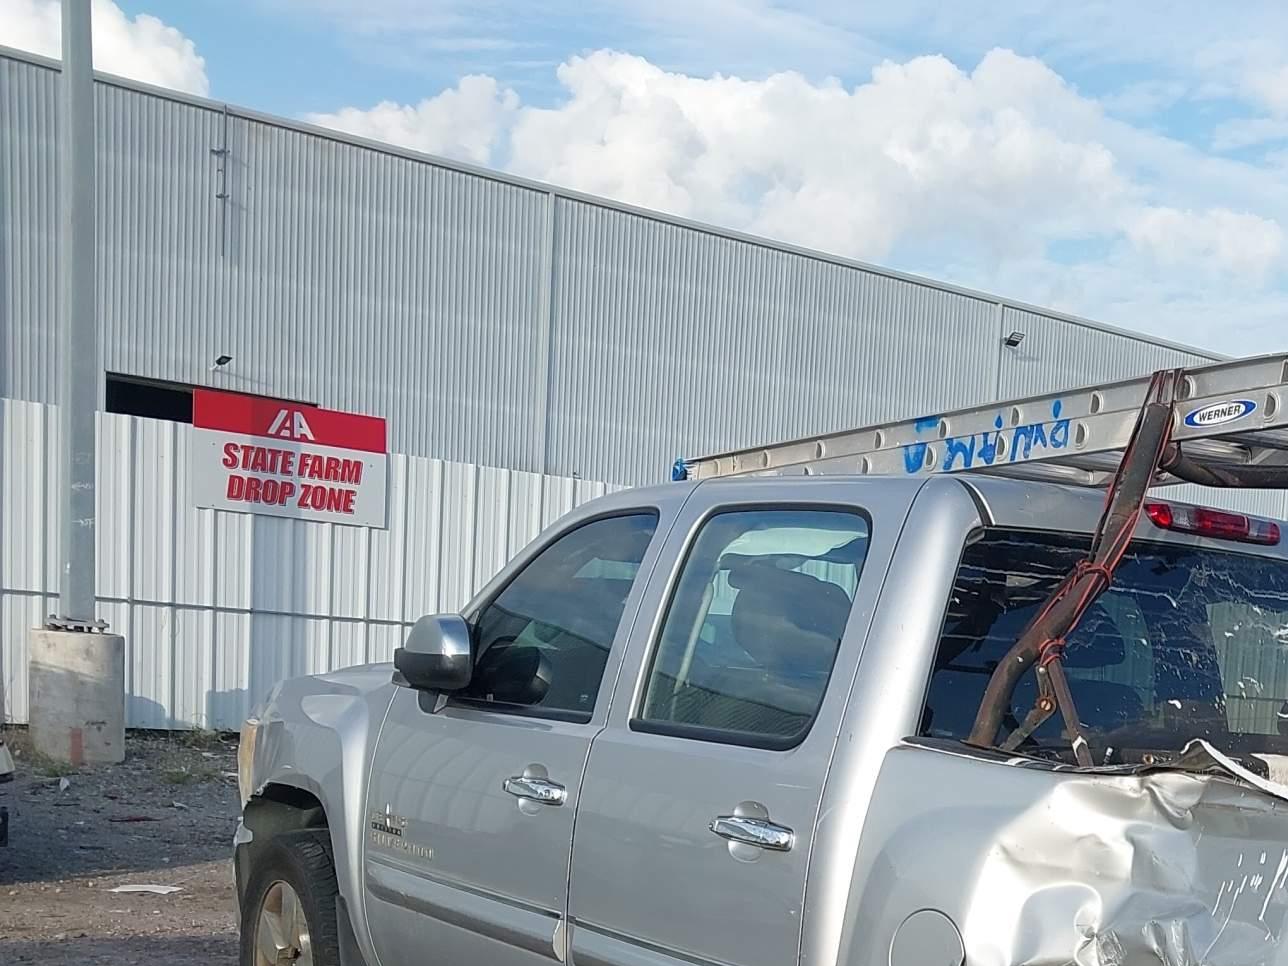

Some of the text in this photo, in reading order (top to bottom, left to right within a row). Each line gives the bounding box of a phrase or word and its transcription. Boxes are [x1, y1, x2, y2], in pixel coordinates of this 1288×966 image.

[1199, 405, 1241, 422] WERNER
[222, 442, 364, 486] STATE FARM
[226, 474, 357, 514] DROP ZONE
